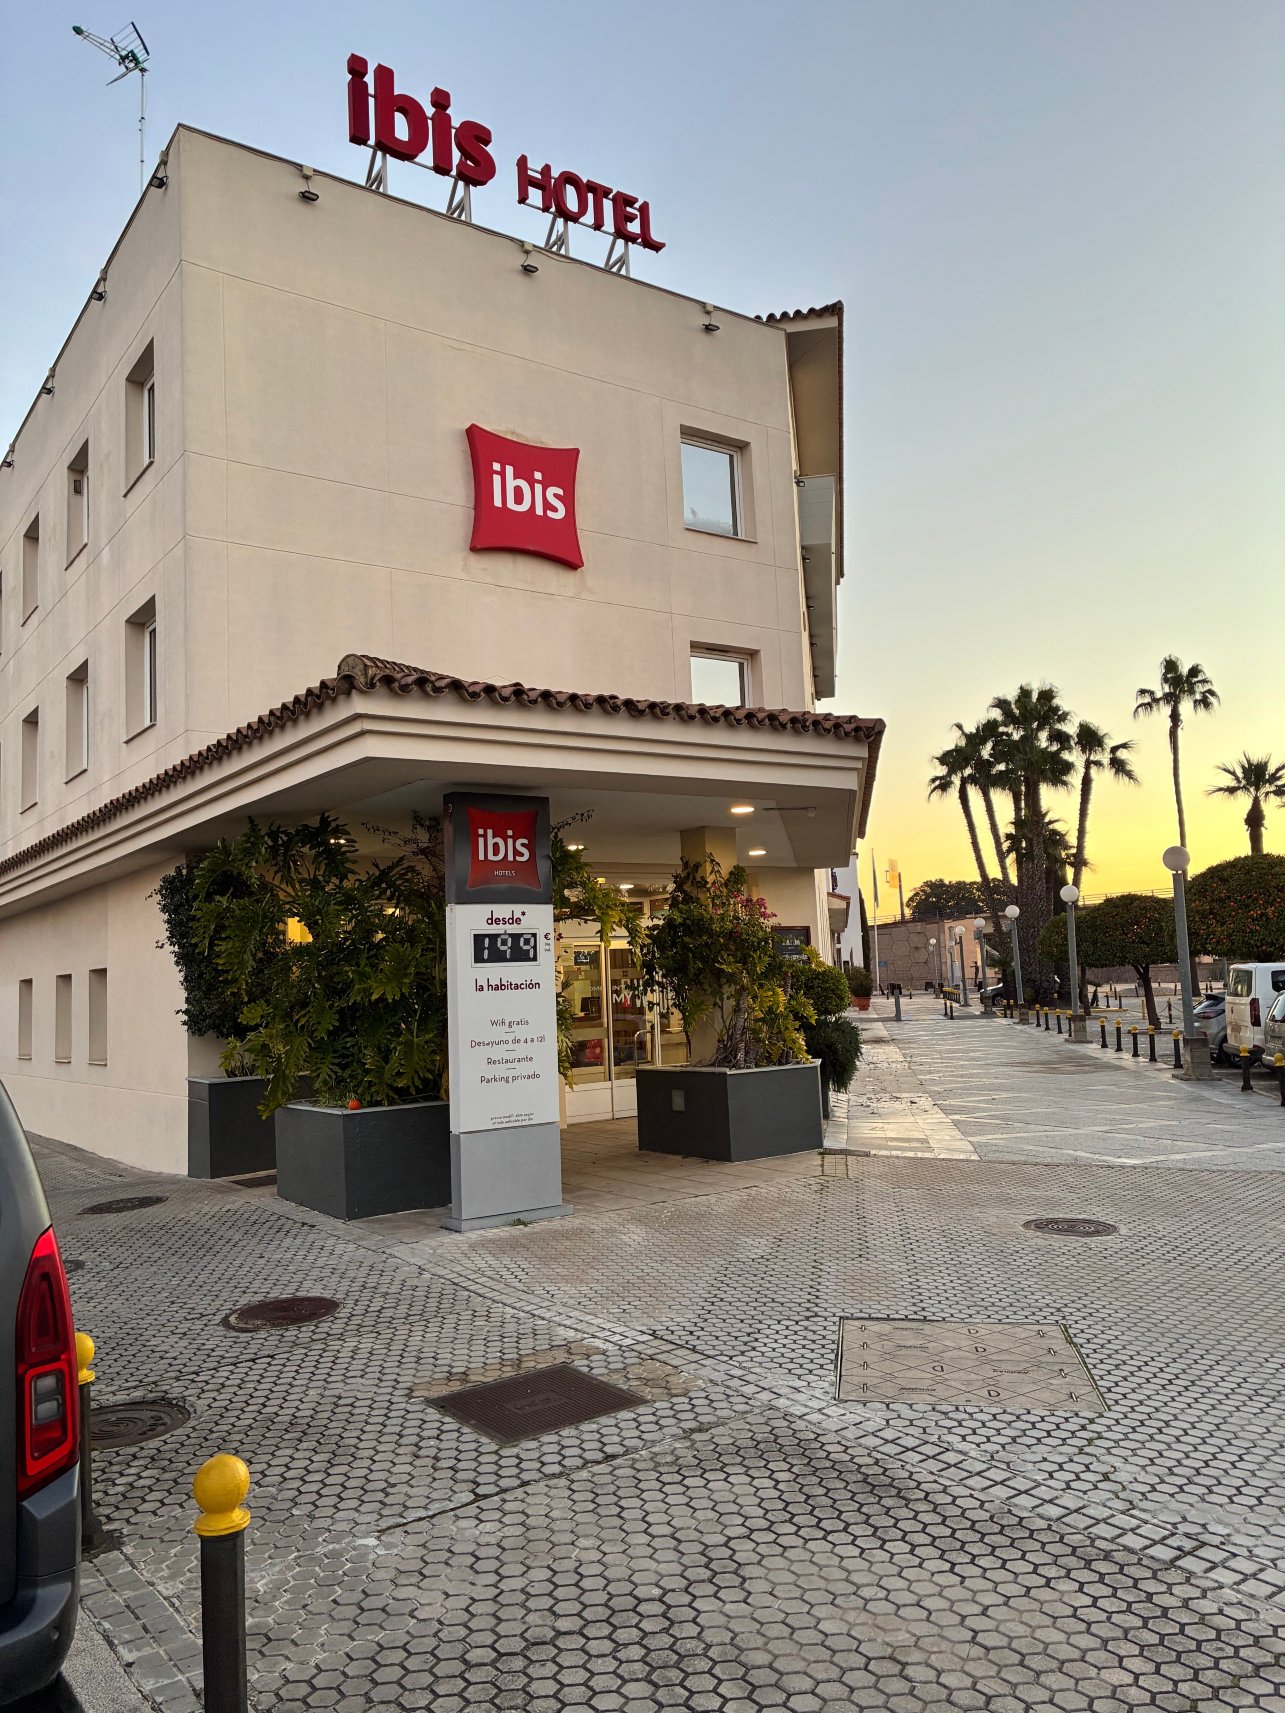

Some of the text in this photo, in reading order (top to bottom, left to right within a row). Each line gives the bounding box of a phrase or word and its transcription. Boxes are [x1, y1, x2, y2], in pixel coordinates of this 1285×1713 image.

[347, 52, 666, 253] ibis HOTEL
[492, 461, 566, 520] ibis
[478, 828, 530, 862] ibis
[483, 934, 535, 960] 199
[475, 977, 541, 992] la habitación
[612, 991, 634, 1005] MY
[490, 1017, 530, 1029] Wifi gratis
[470, 1039, 510, 1049] Desayuno
[511, 1035, 521, 1045] de
[486, 1054, 534, 1066] Restaurante
[480, 1070, 541, 1084] Parking privado
